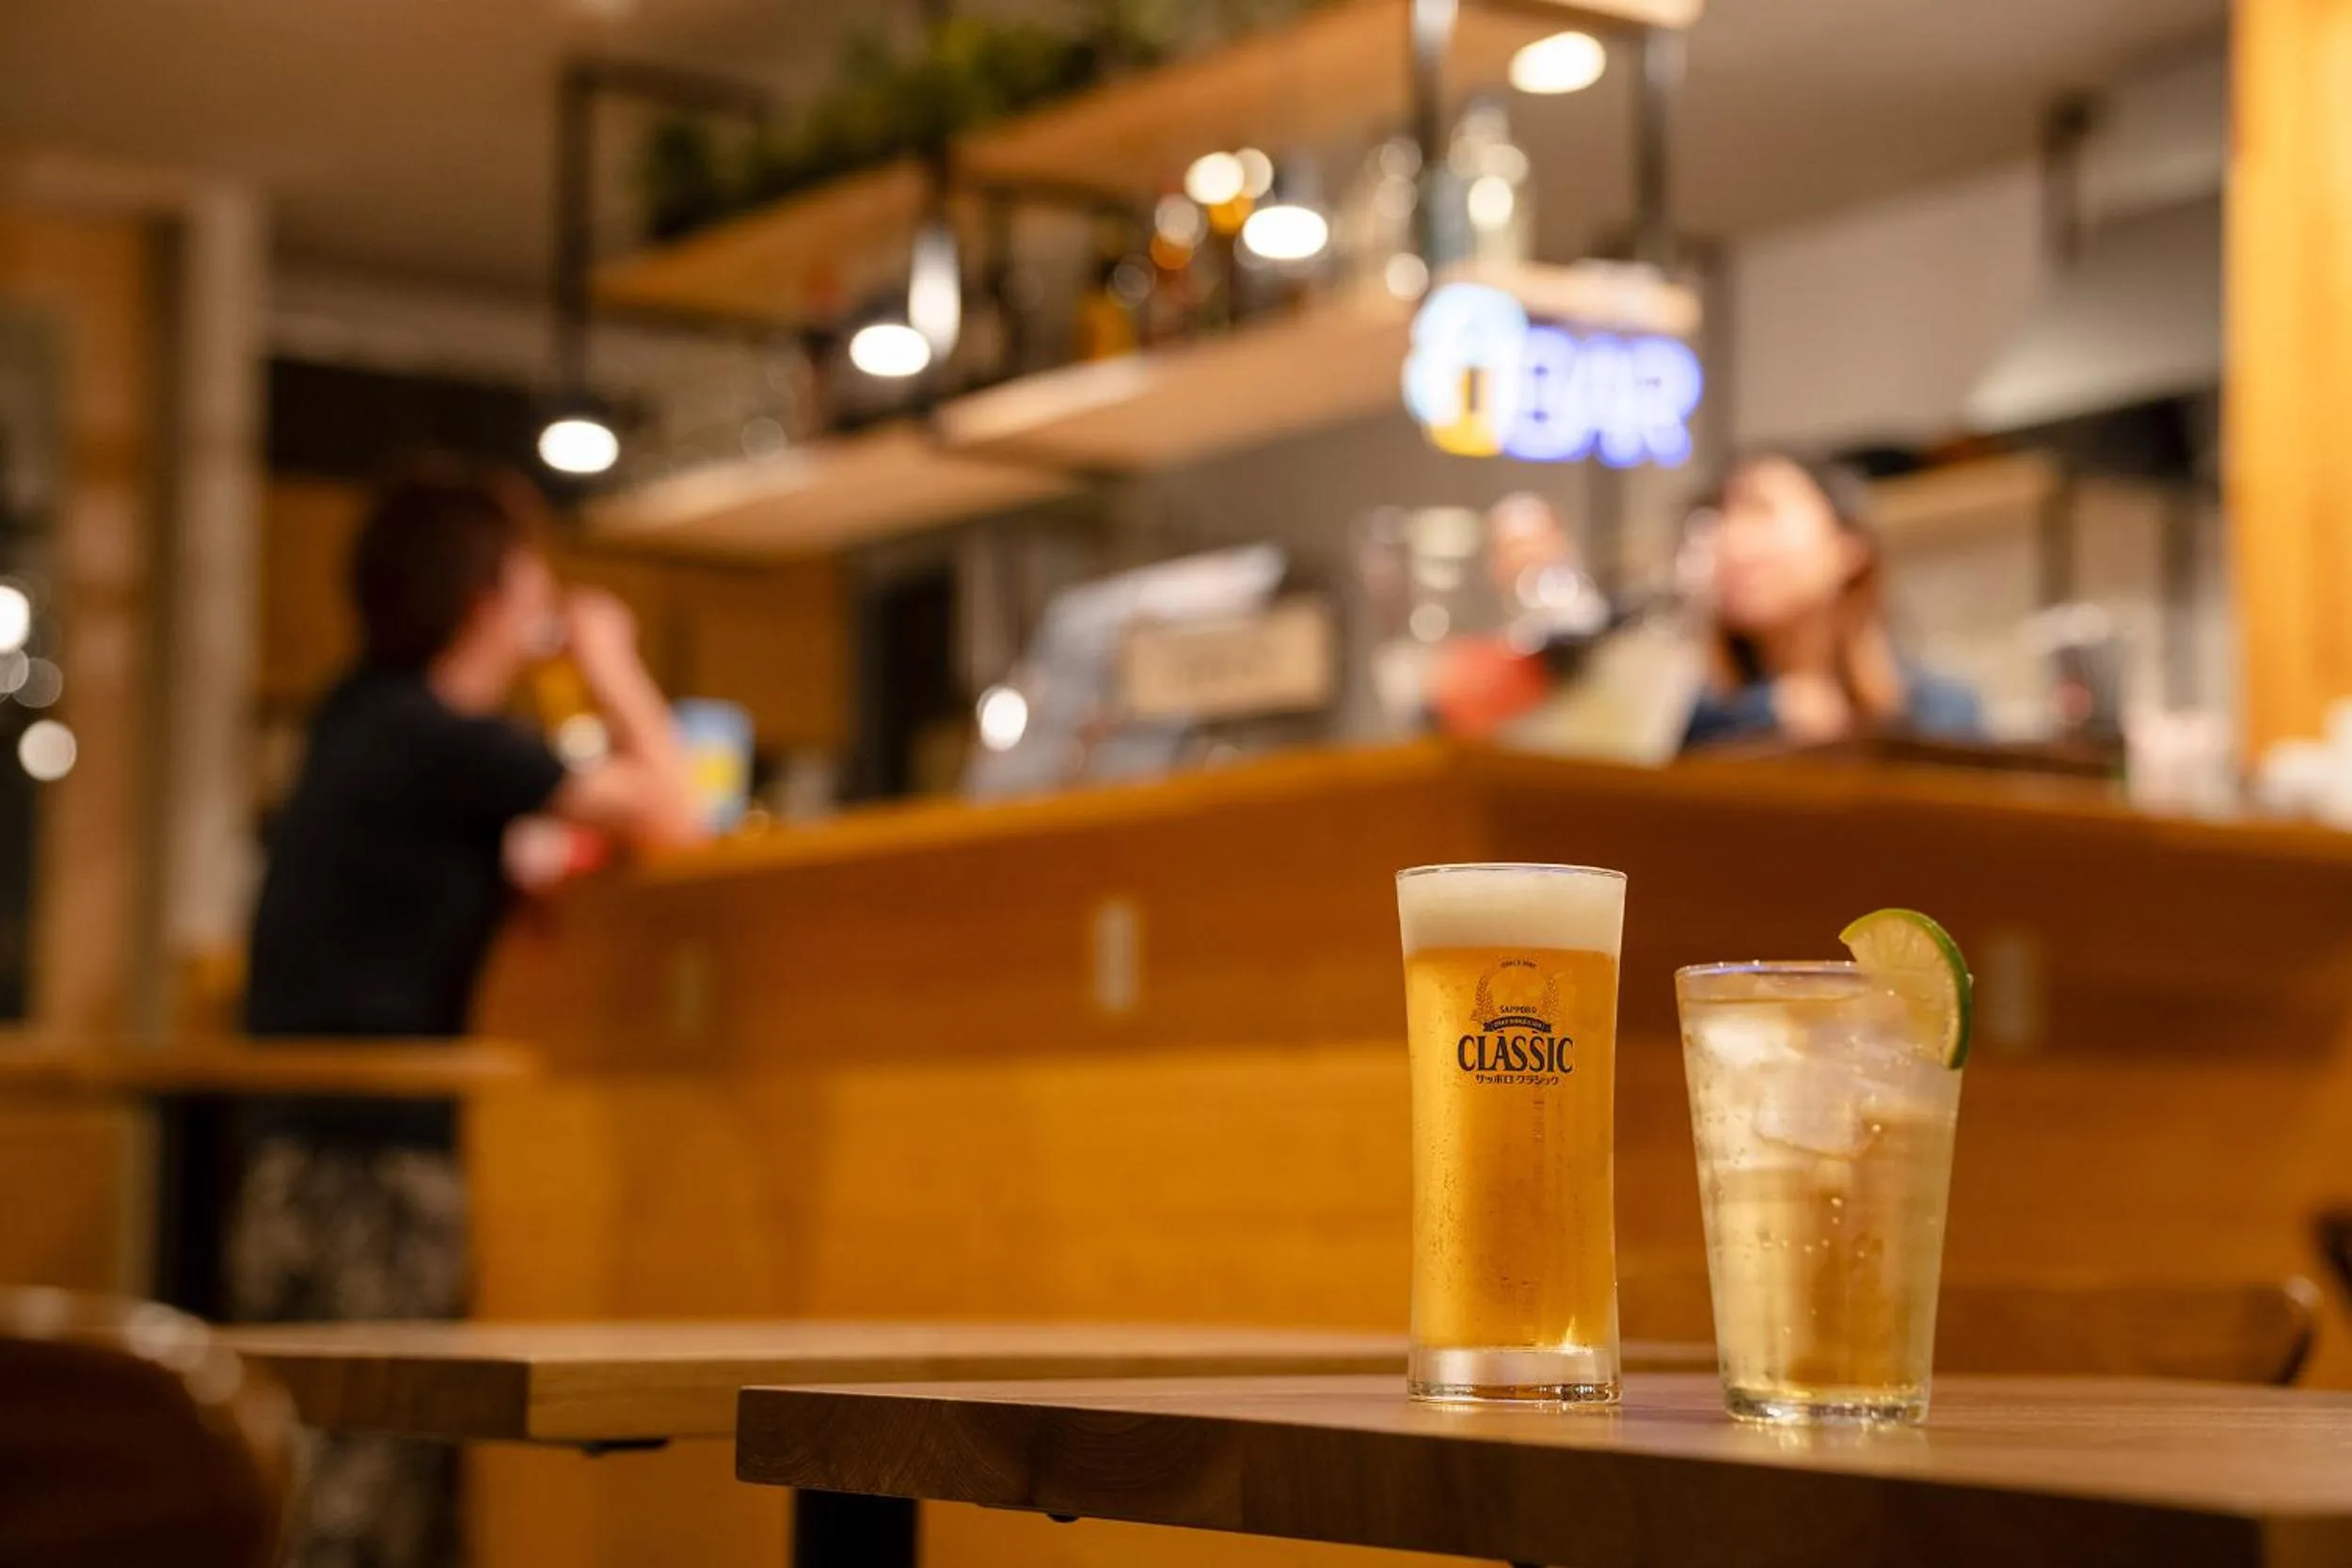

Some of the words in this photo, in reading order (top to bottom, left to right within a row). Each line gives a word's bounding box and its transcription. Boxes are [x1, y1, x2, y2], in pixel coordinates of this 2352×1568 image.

[1506, 326, 1703, 468] BAR
[1500, 1005, 1537, 1014] SAPPORO
[1457, 1034, 1574, 1073] CLASSIC
[1475, 1073, 1514, 1085] サッポロ
[1516, 1074, 1559, 1085] クラシック
